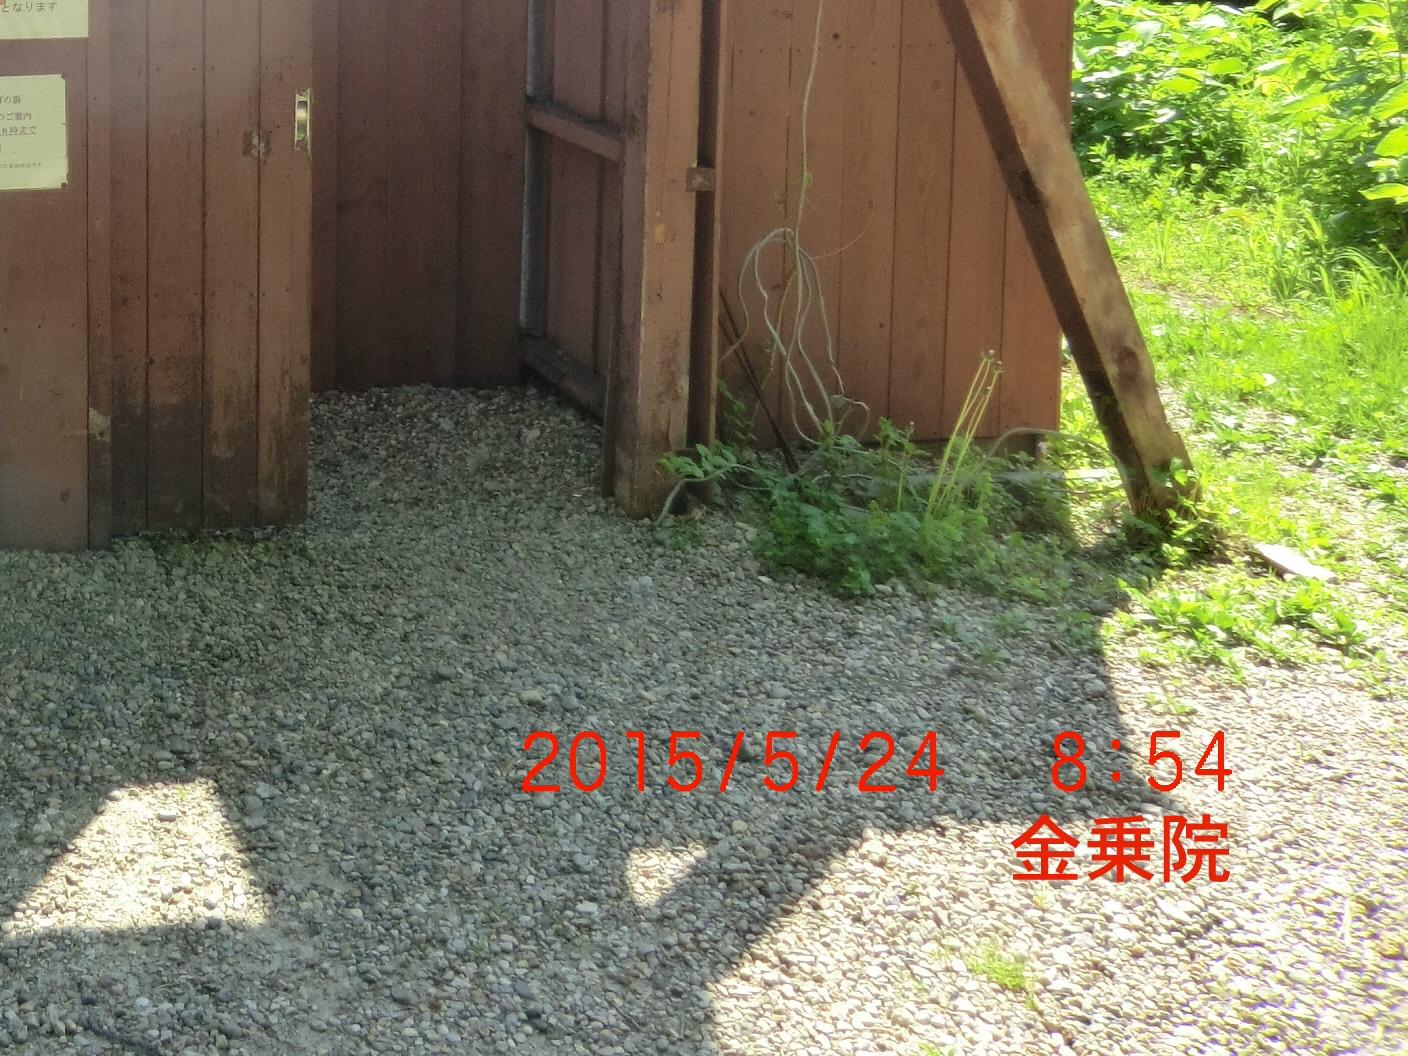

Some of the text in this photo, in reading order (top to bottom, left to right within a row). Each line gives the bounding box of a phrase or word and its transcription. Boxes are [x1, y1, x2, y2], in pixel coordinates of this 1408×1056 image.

[2, 1, 58, 13] となります
